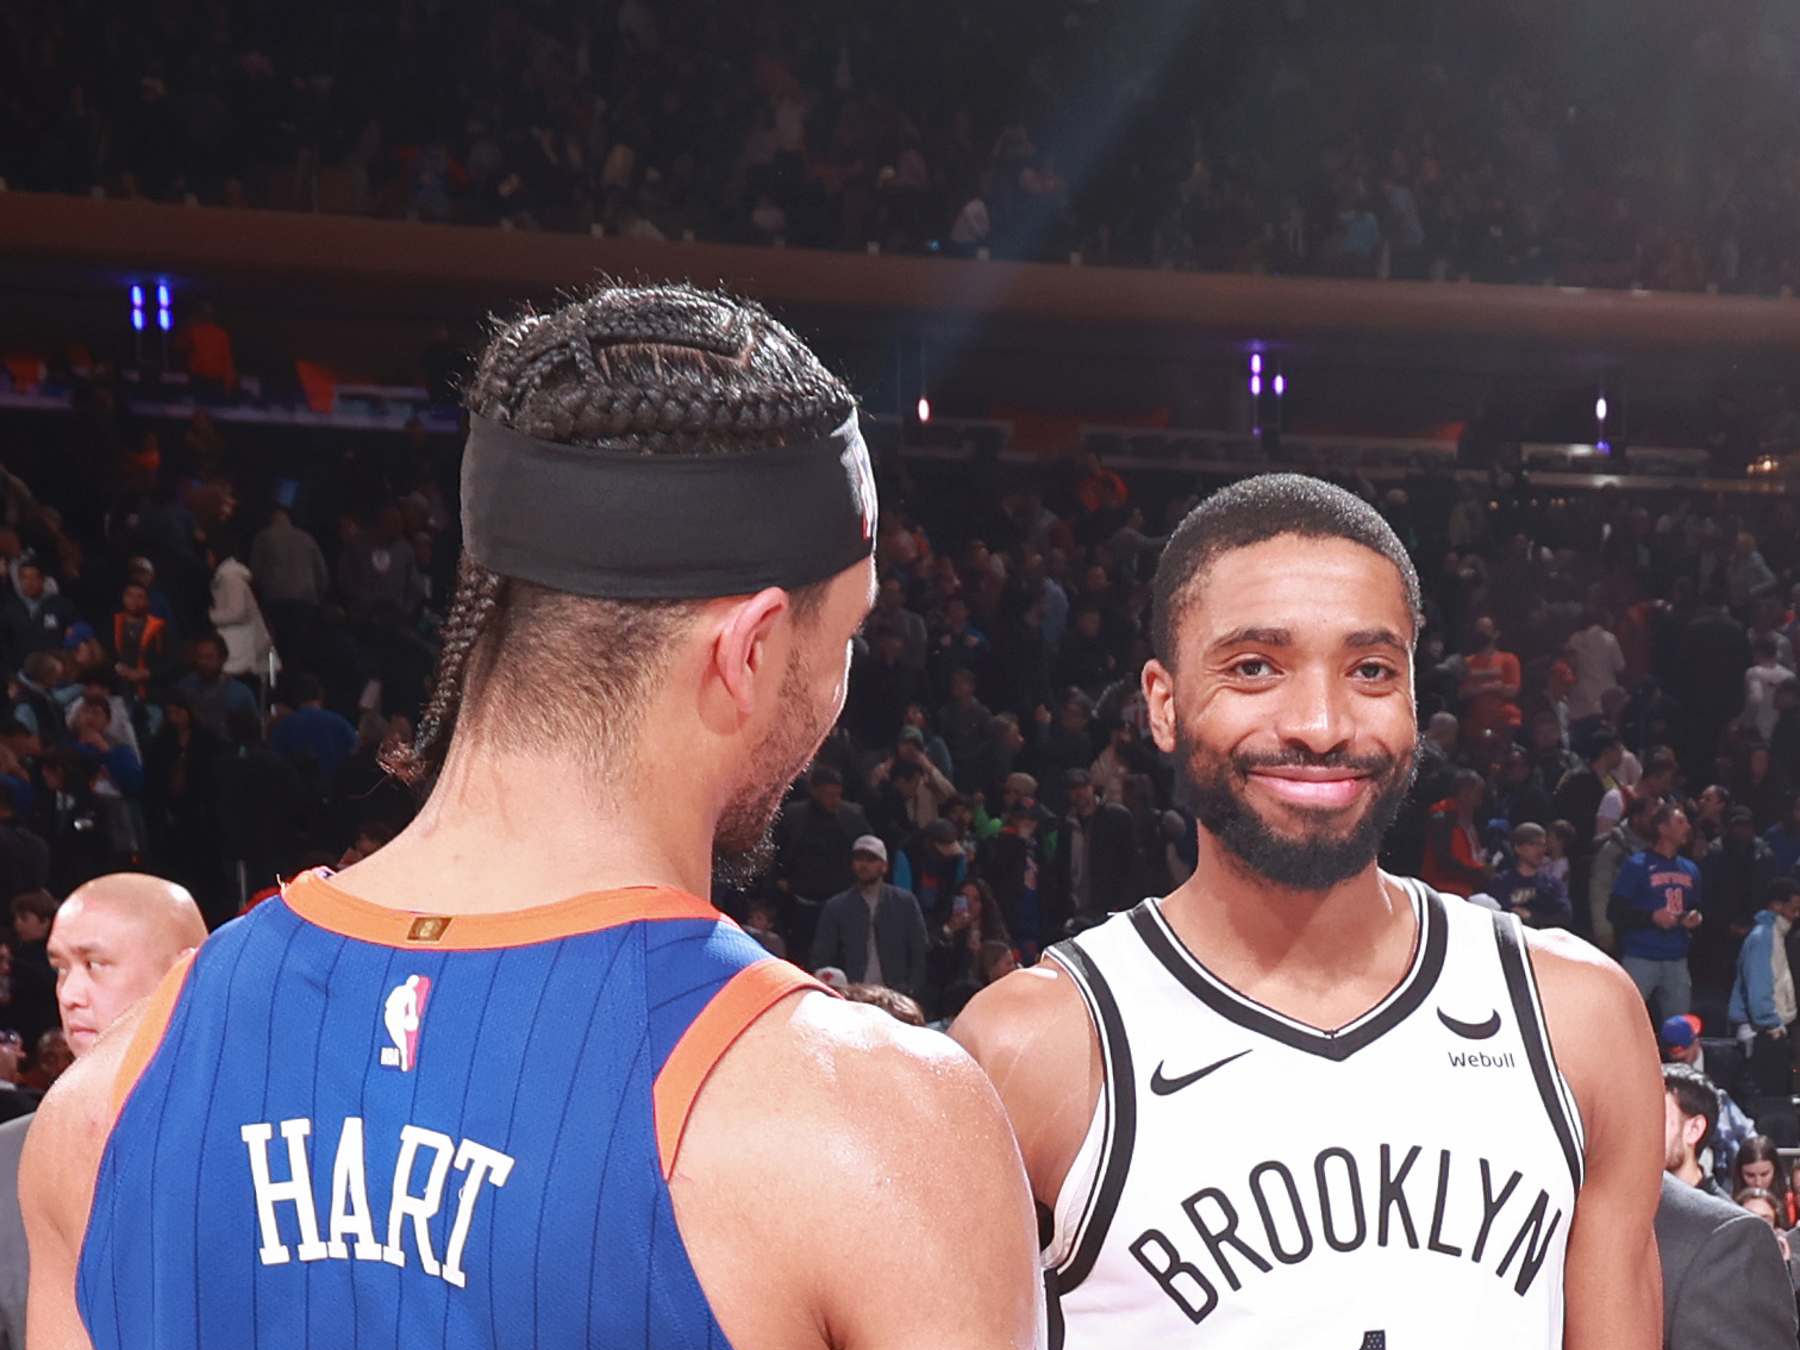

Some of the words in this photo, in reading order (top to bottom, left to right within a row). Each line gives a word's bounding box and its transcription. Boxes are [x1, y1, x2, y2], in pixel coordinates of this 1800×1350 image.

[1448, 1051, 1515, 1069] Webull
[241, 1117, 515, 1288] HART
[1128, 1143, 1562, 1325] BROOKLYN
